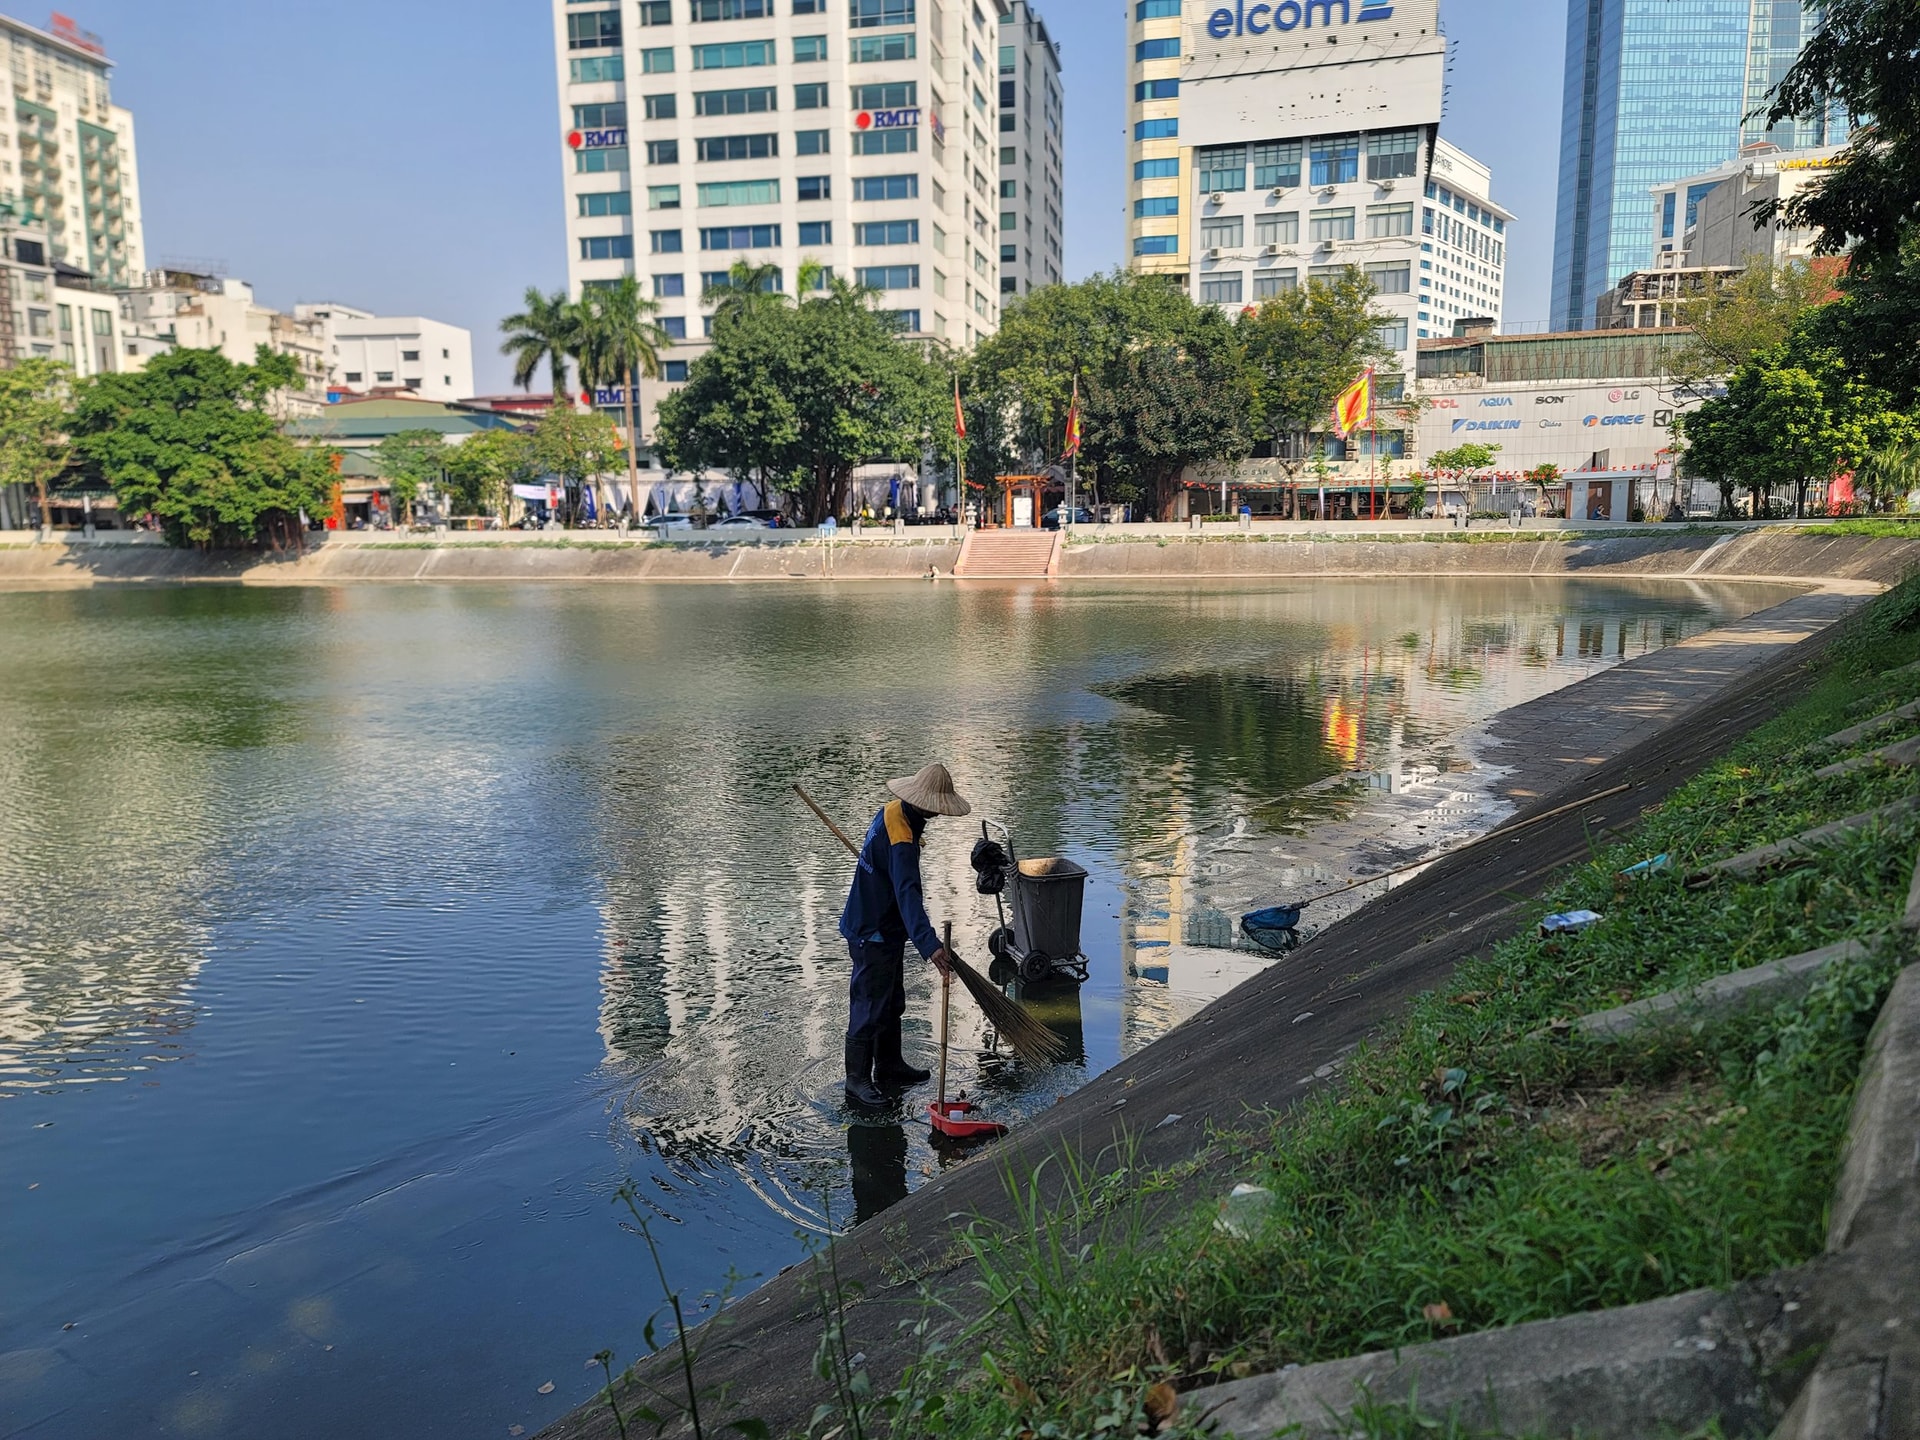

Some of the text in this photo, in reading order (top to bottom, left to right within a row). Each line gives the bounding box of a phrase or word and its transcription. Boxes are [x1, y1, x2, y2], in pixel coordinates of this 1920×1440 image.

[1207, 0, 1349, 38] elcom
[874, 109, 921, 127] RMIT
[585, 130, 627, 147] RMIT
[1479, 396, 1512, 407] AQUA
[1535, 395, 1575, 404] SON
[1624, 390, 1640, 401] LG
[1431, 399, 1459, 409] TCL
[1465, 419, 1521, 431] DAIKIN
[1601, 414, 1646, 426] GREE
